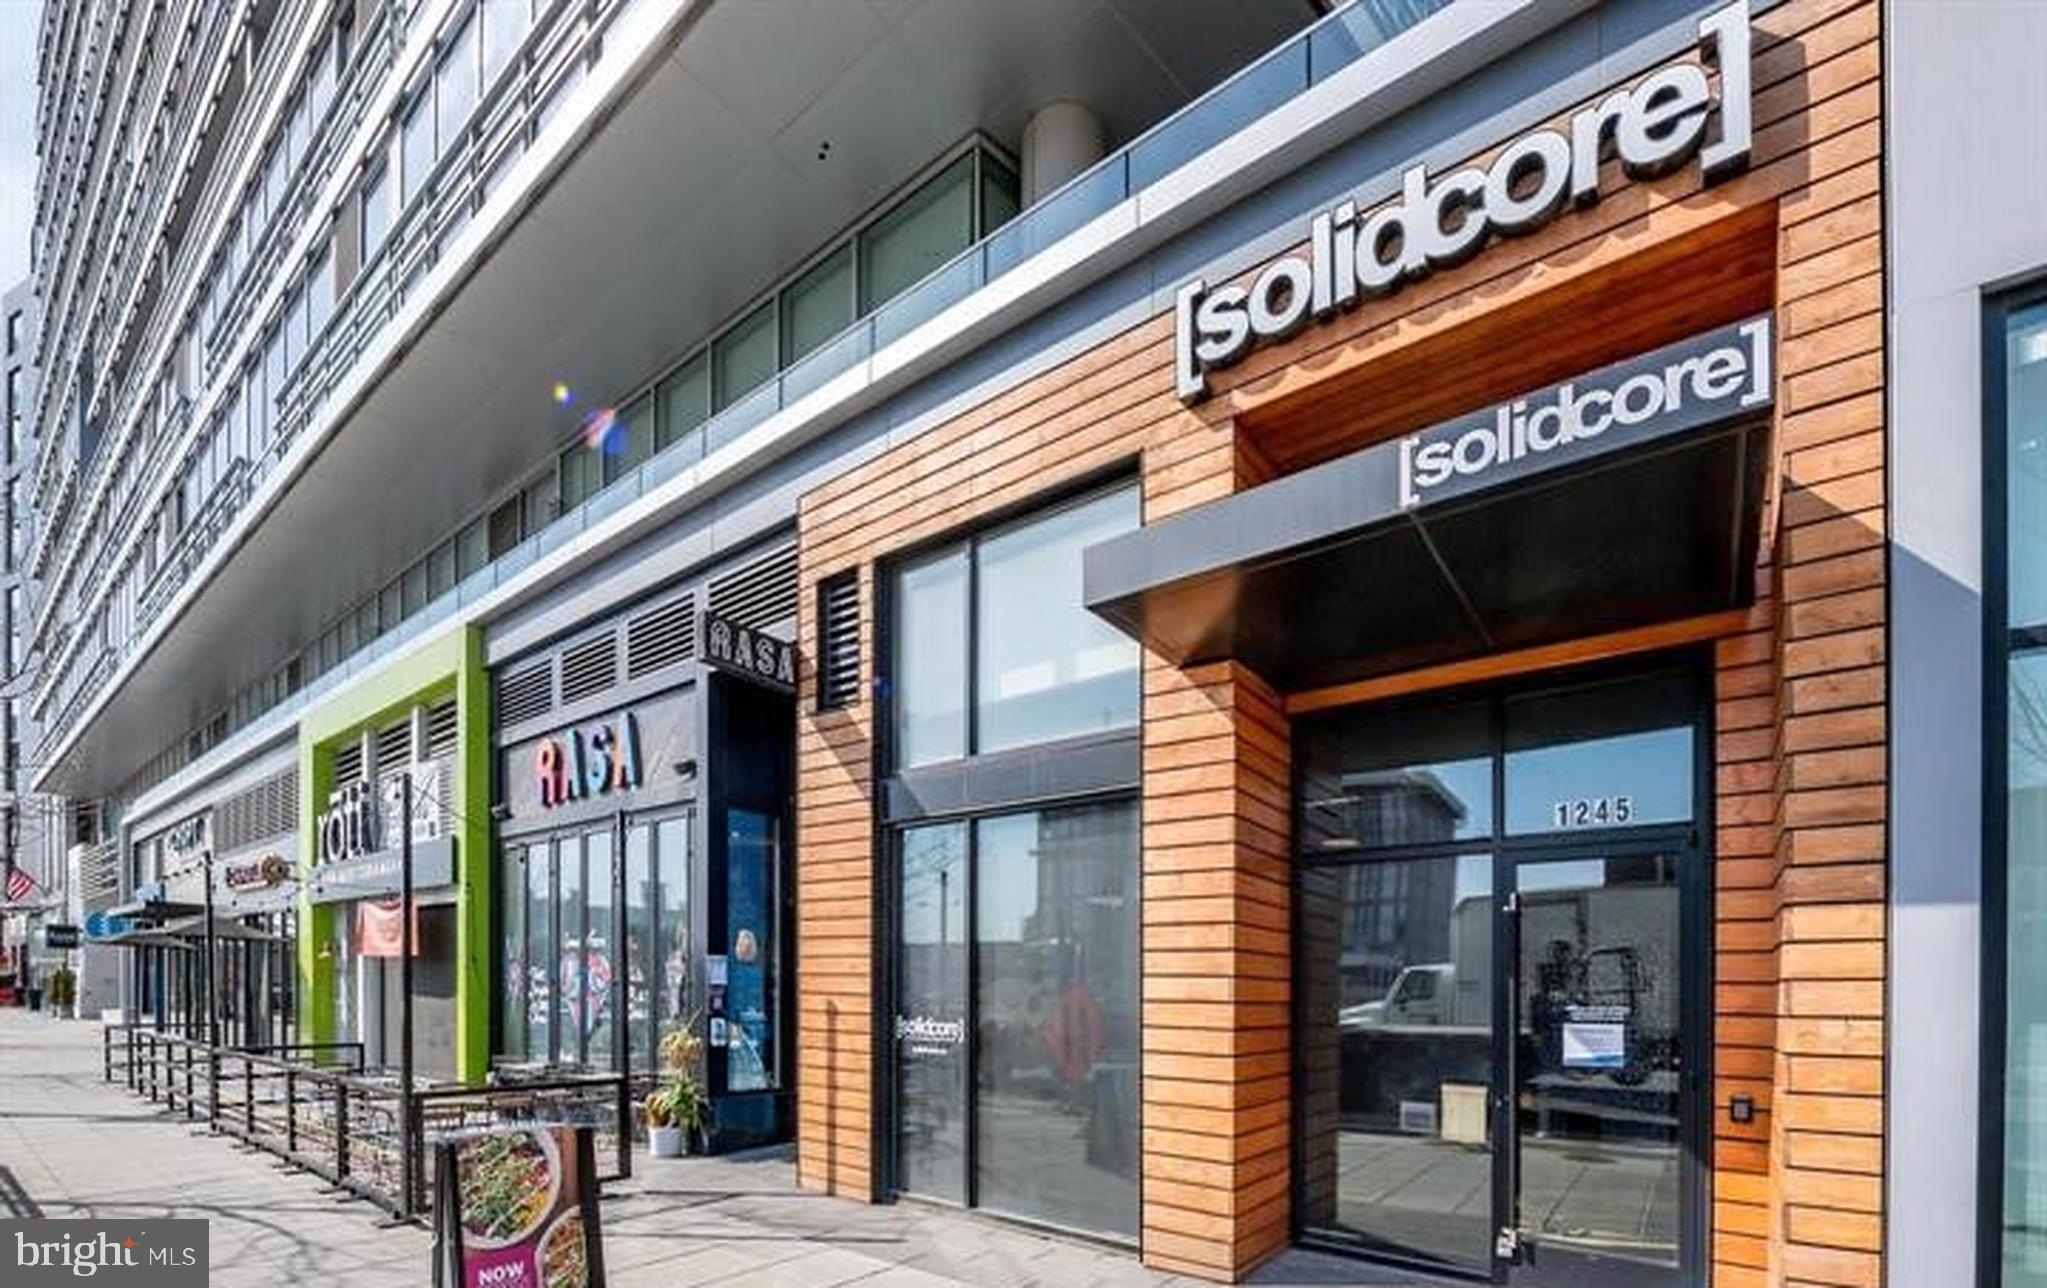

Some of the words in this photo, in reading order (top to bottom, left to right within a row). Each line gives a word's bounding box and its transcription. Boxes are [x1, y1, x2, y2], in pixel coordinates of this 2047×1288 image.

[1400, 317, 1771, 509] [solidcore]
[709, 619, 795, 684] RASA
[535, 712, 642, 809] RASA
[1556, 797, 1631, 827] 1245
[477, 1261, 524, 1286] NOW
